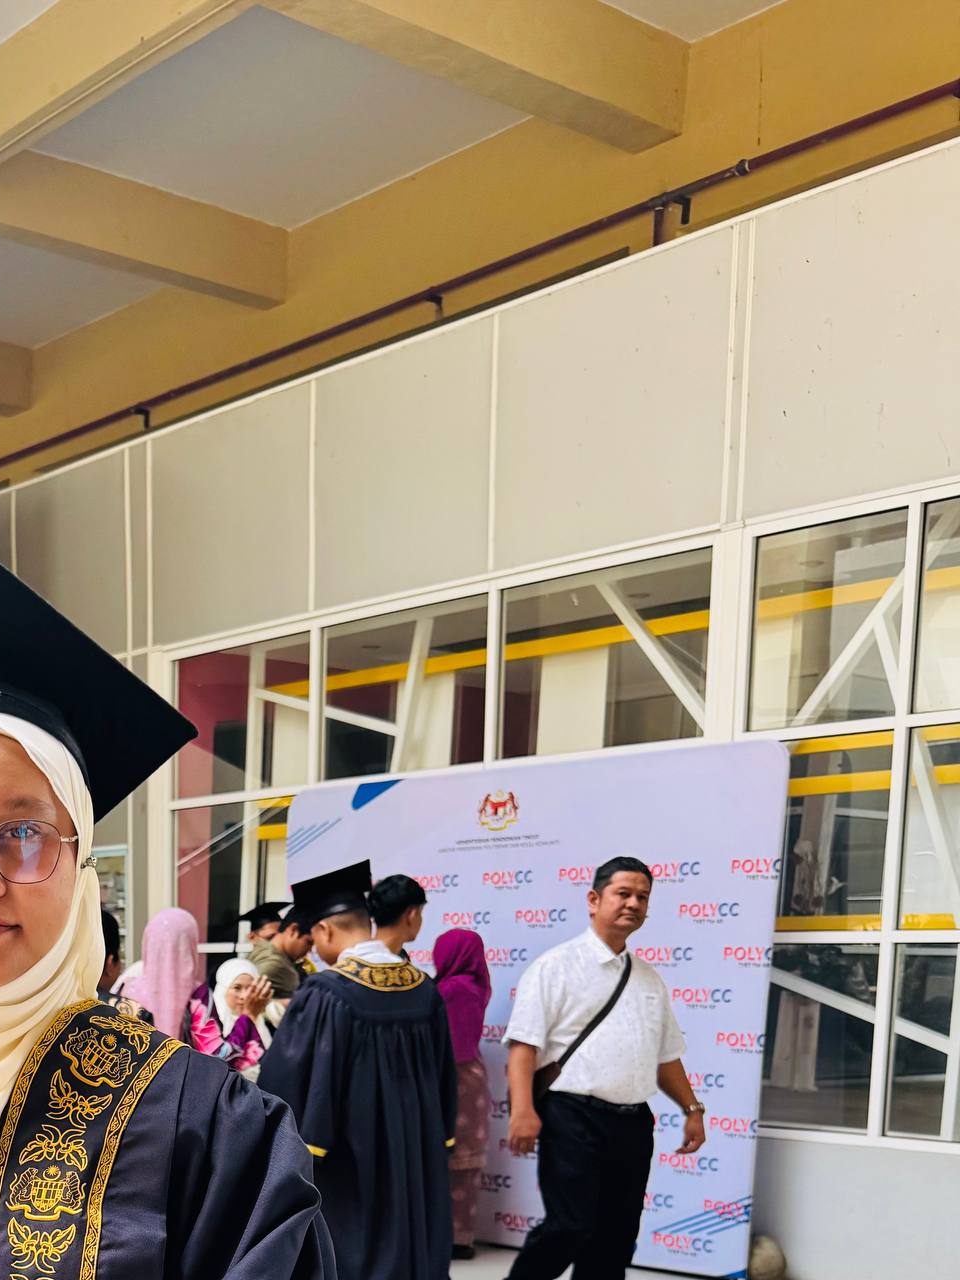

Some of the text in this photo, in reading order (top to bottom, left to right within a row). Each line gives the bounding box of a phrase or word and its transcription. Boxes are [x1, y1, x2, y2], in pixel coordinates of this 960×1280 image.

[558, 864, 595, 881] POLY
[731, 858, 781, 874] POLYC
[482, 869, 533, 886] POLYCC
[442, 911, 491, 926] POLYCC
[514, 908, 567, 924] POLYCC
[678, 902, 740, 919] POLYCC
[484, 948, 528, 963] OLYCC
[723, 946, 772, 962] POLYC
[671, 988, 733, 1004] POLYCC
[715, 1031, 767, 1048] POLYC
[687, 1072, 725, 1089] LYCC
[709, 1116, 758, 1134] POLYC
[658, 1152, 719, 1172] POLYCC
[652, 1231, 713, 1254] POLYCC
